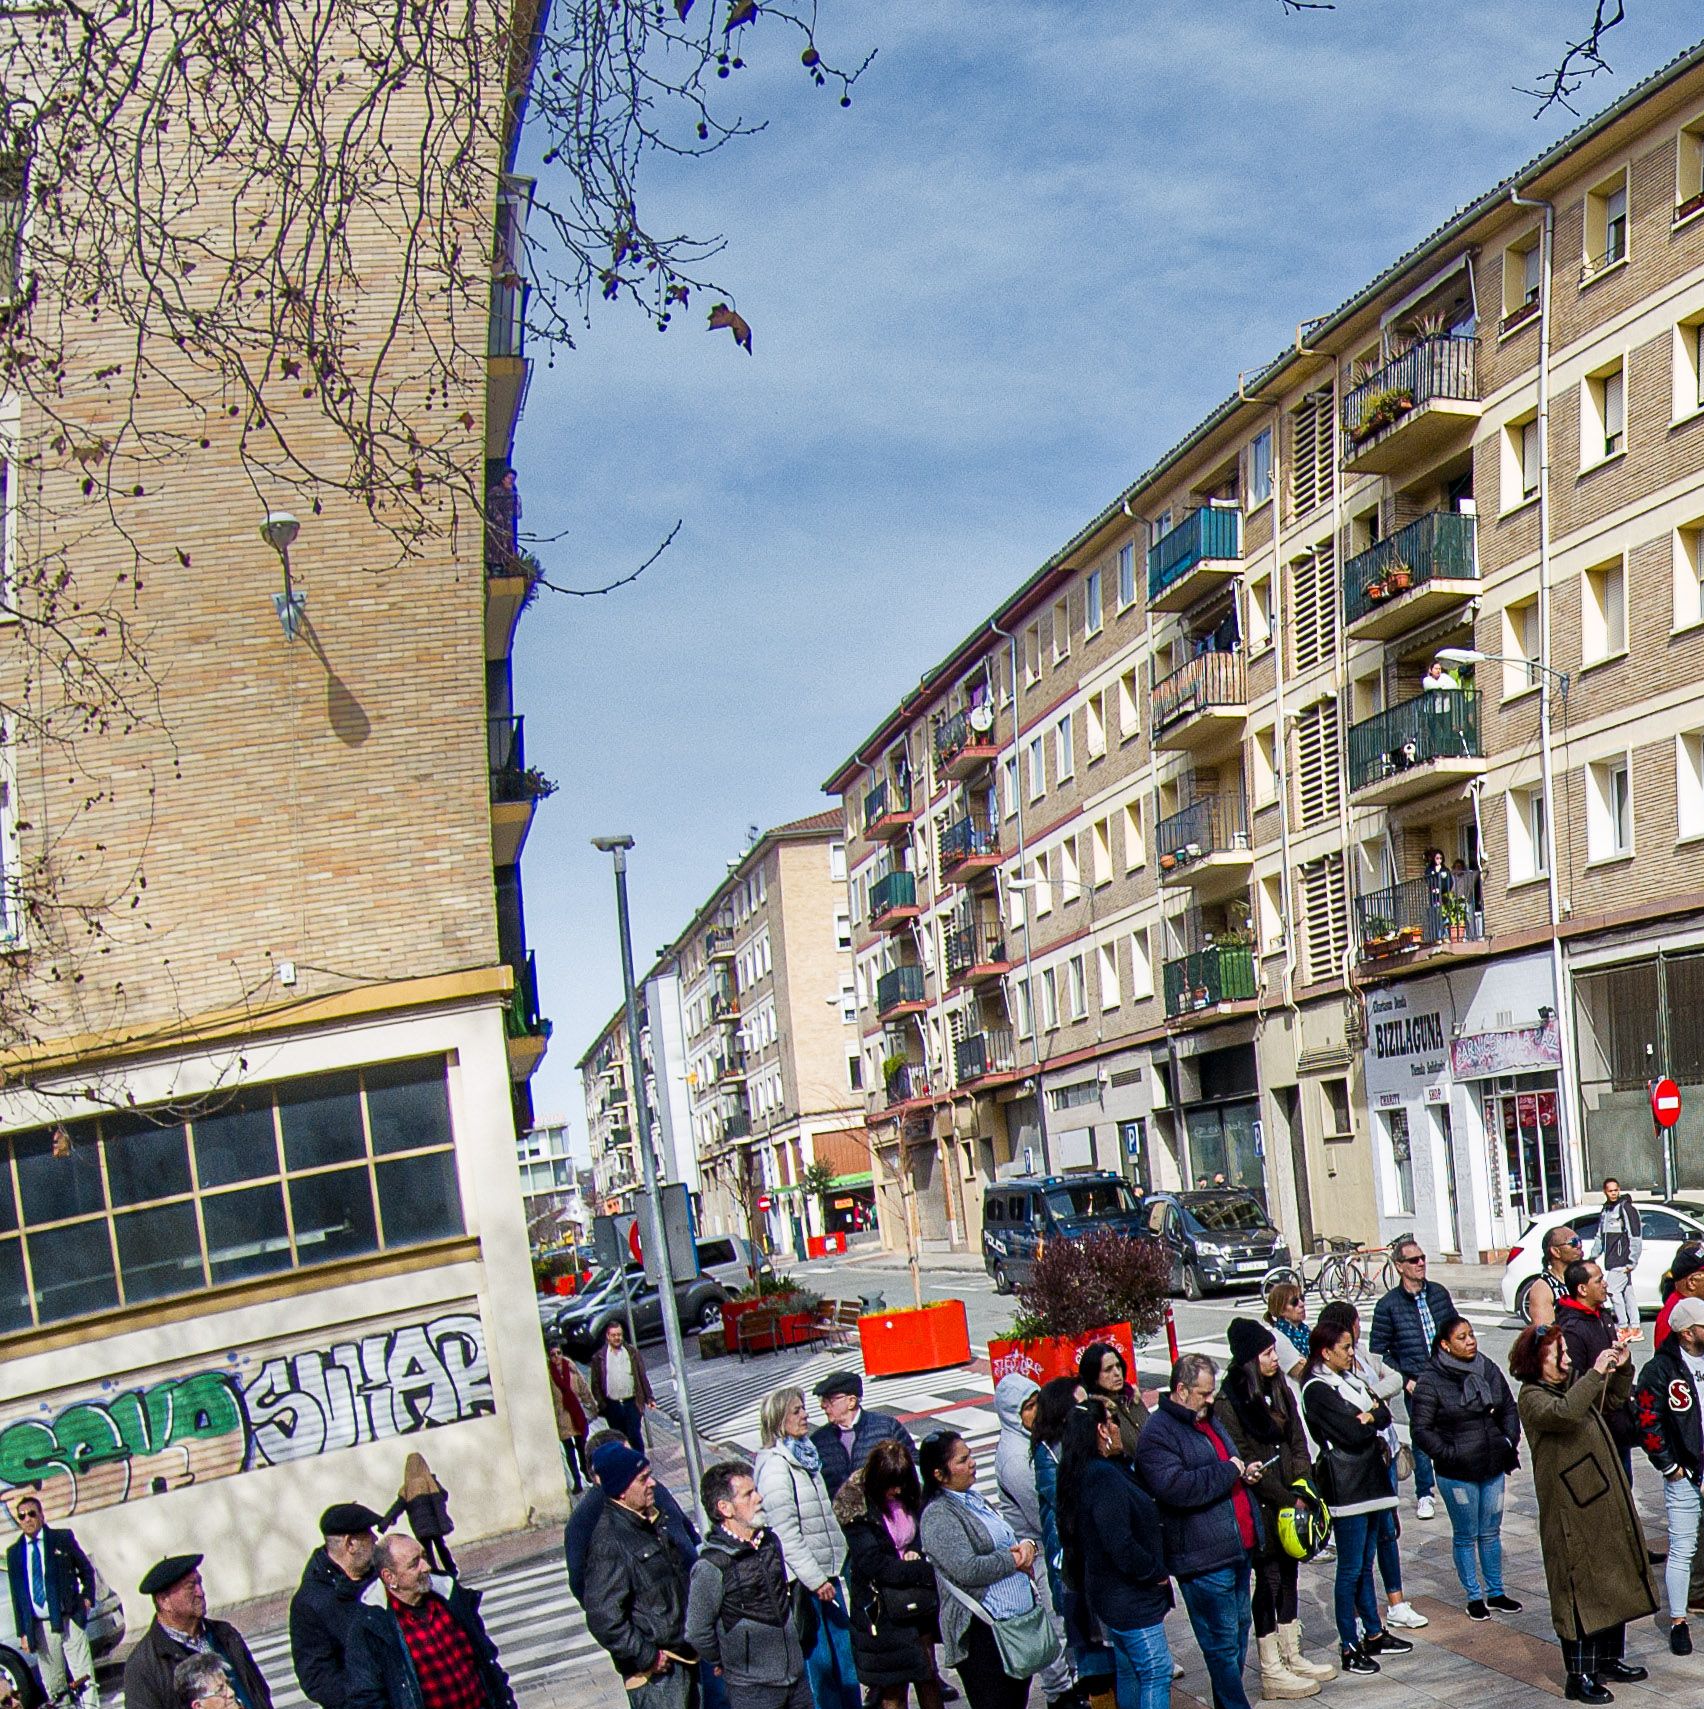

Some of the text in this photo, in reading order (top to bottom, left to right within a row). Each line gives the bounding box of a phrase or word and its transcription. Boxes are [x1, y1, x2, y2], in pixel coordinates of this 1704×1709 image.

[1375, 1012, 1444, 1059] BIZILAGUNA
[1128, 1129, 1135, 1151] P
[1254, 1129, 1261, 1156] P
